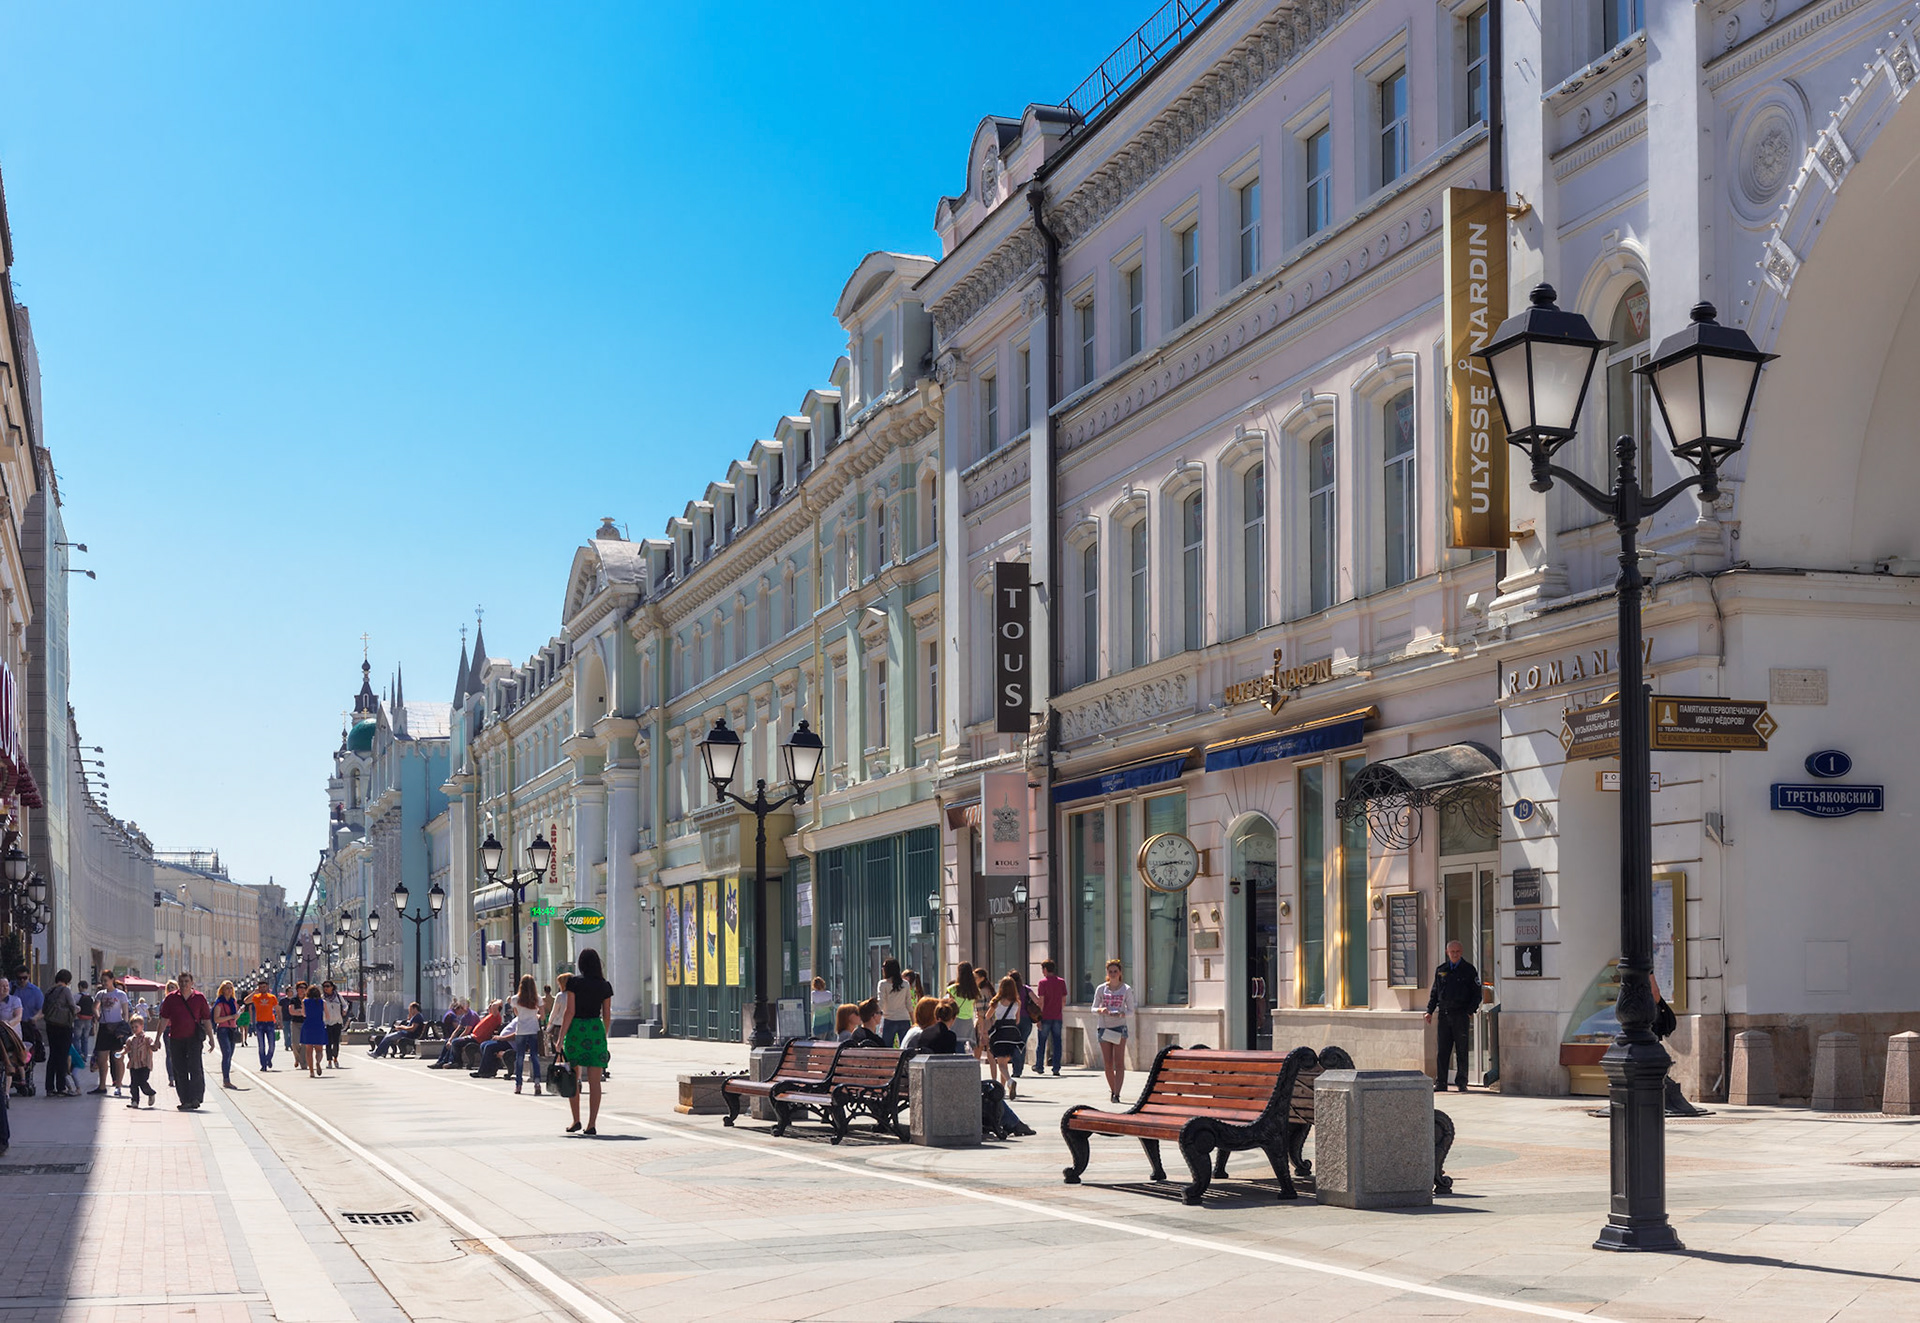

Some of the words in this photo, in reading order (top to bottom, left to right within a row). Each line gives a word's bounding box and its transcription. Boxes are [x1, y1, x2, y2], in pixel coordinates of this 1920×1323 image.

[1470, 222, 1488, 352] NARDIN
[1470, 384, 1490, 514] ULYSSE
[1002, 588, 1024, 707] TOUS
[1225, 674, 1273, 704] ULYSSE
[1279, 658, 1332, 690] NARDIN
[1586, 710, 1610, 722] КАМЕРНЫЙ
[1680, 704, 1710, 714] ПАМЯТНИК
[1711, 706, 1761, 716] ПЕРВОПЕЧАТНИКУ
[1574, 722, 1608, 735] МУЗЫКАЛЬНЫЙ
[1608, 719, 1620, 728] ТЕАТ
[1695, 716, 1714, 724] ИВАНУ
[1715, 715, 1745, 725] ФЁДОРОВУ
[1829, 756, 1835, 771] 1
[1786, 790, 1874, 804] ТРЕТЬЯКОВСКИЙ
[1519, 803, 1529, 817] 19
[549, 823, 557, 884] АВИАКАССЫ
[532, 907, 555, 916] 14:43
[988, 896, 1014, 914] TOUS
[566, 916, 604, 925] SUBWAY
[1517, 926, 1538, 935] GUESS
